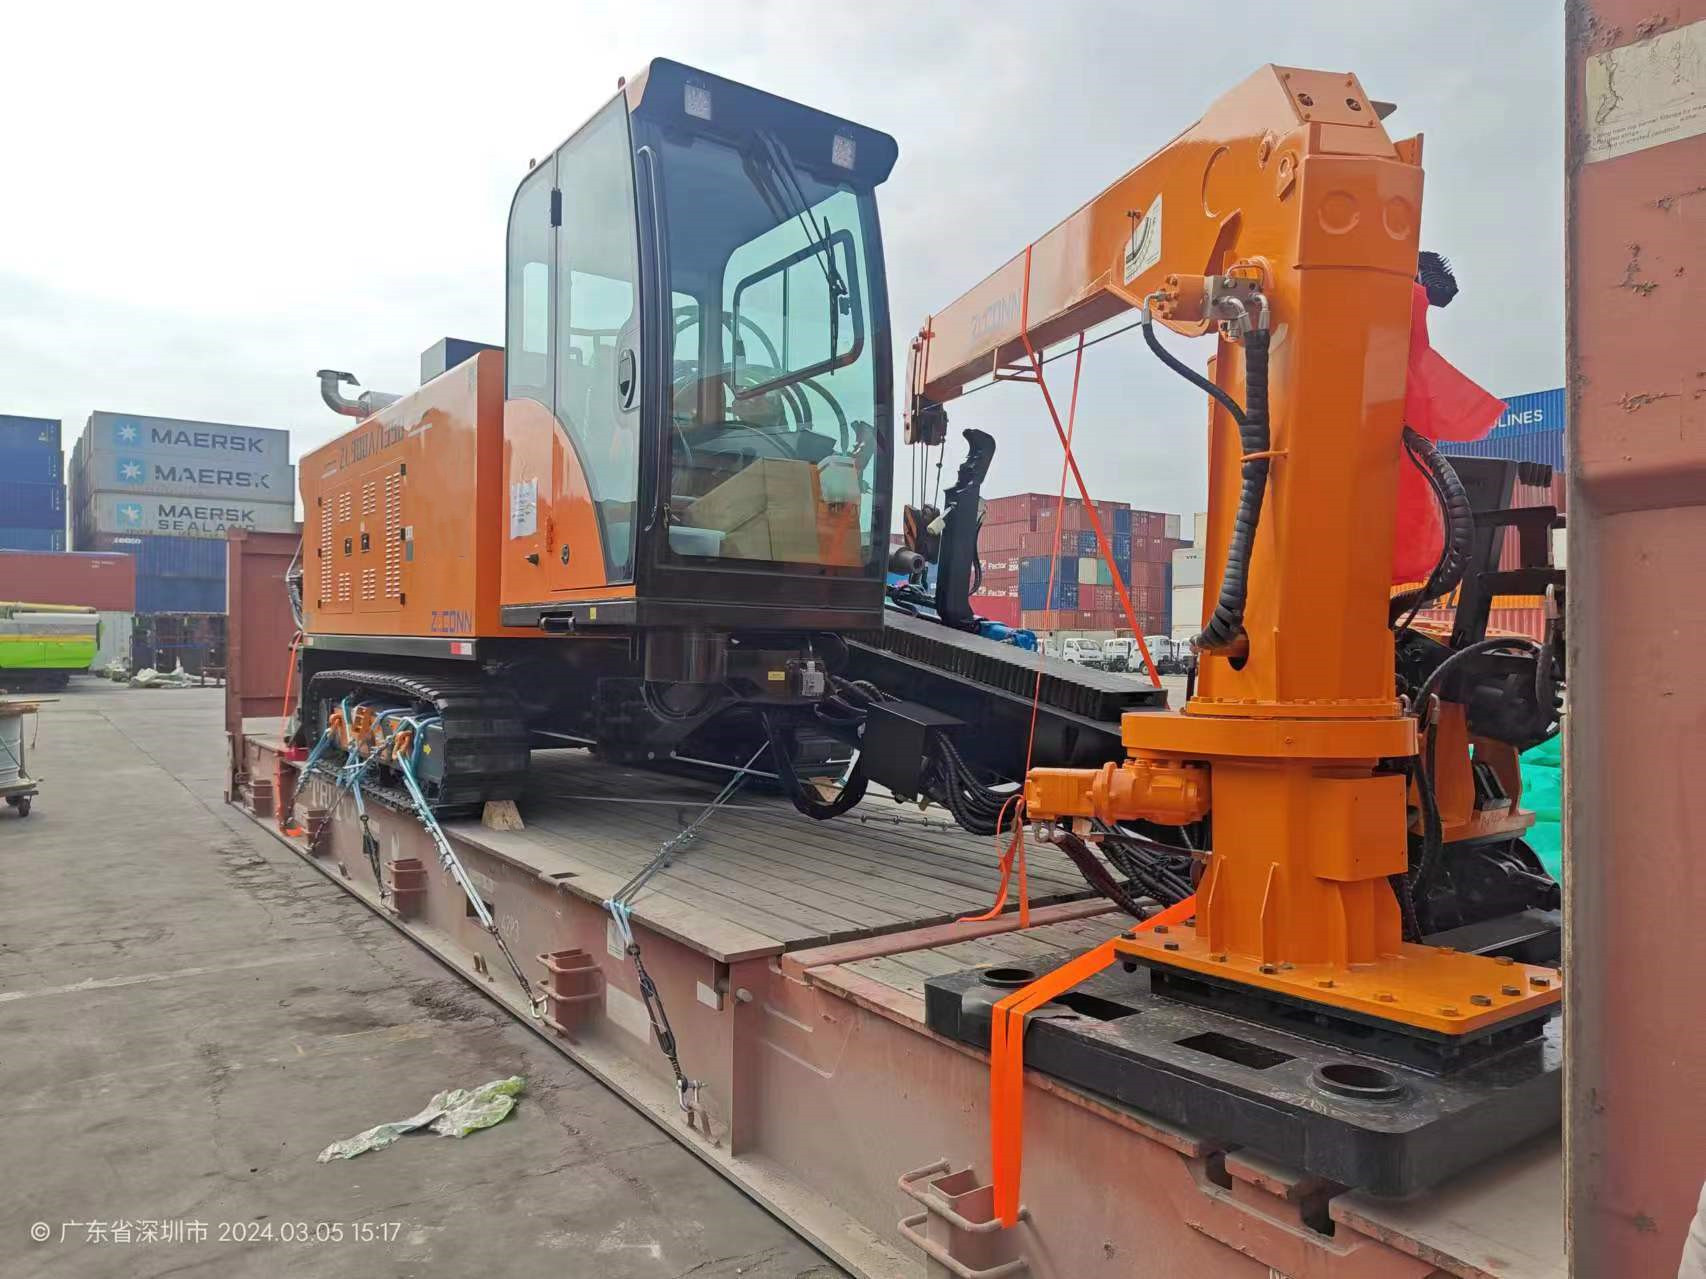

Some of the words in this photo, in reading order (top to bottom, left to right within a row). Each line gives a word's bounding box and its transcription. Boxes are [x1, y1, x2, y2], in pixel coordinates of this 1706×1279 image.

[151, 427, 265, 453] MAERSK
[154, 464, 271, 489] MAERSK
[158, 503, 255, 522] MAERSK
